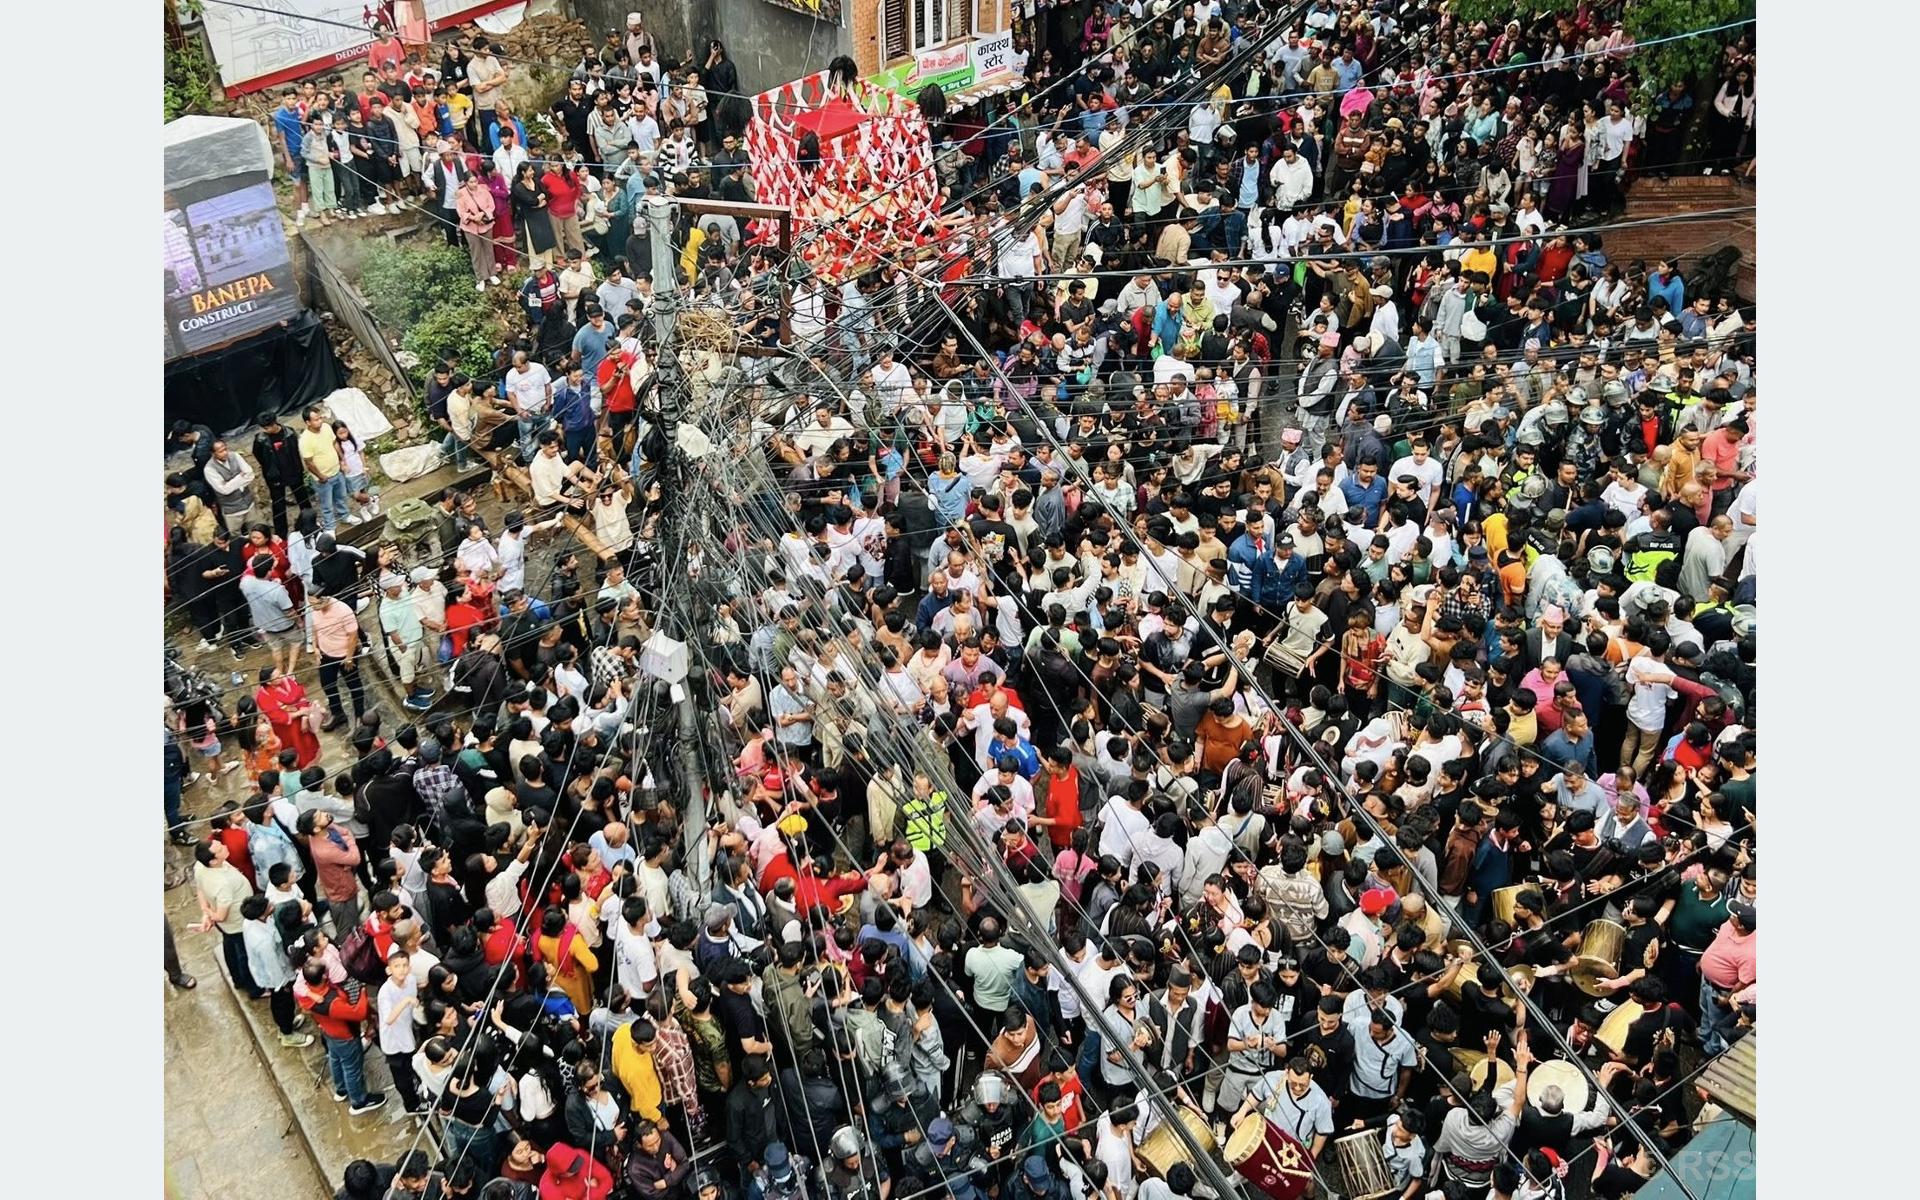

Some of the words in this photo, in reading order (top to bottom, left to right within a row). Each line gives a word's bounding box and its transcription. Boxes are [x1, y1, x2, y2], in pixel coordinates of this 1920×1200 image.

[335, 44, 373, 61] DEDICAT
[977, 37, 1010, 56] कायस्थ
[984, 54, 1003, 69] स्टोर
[192, 273, 274, 313] BANEPA
